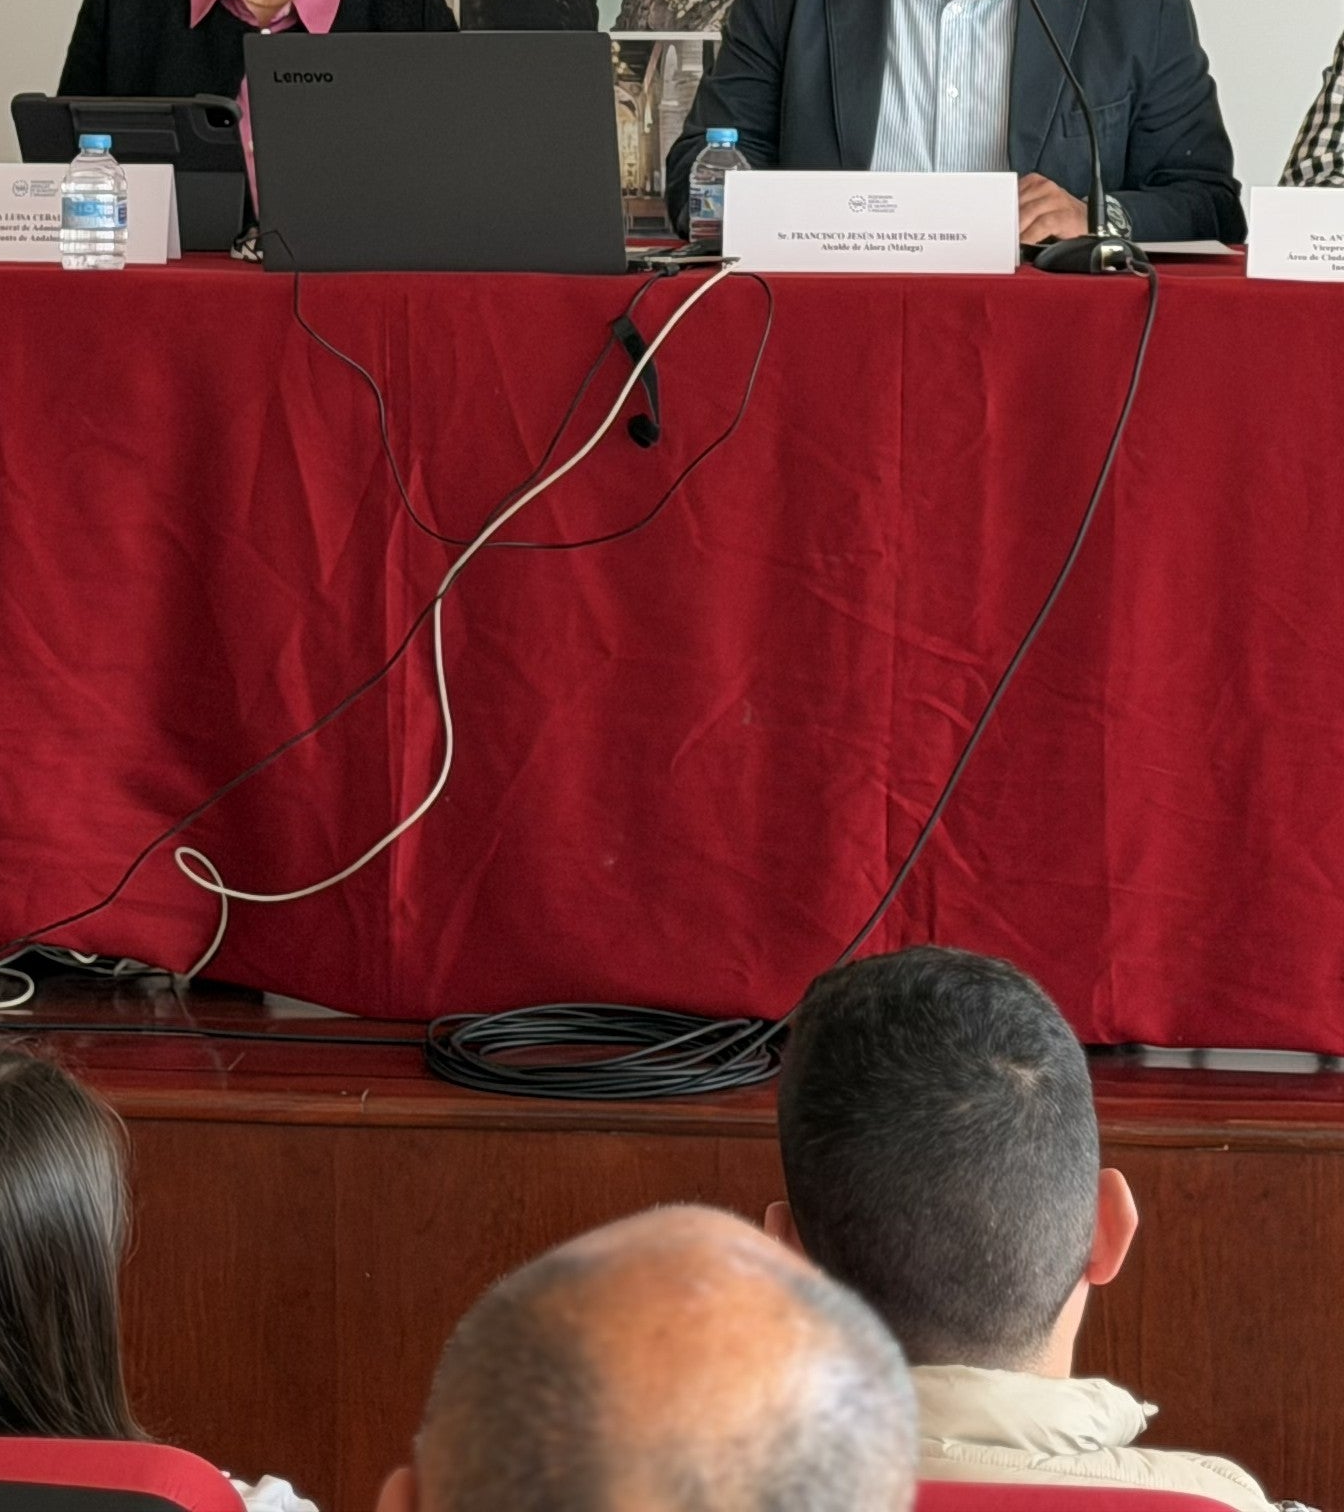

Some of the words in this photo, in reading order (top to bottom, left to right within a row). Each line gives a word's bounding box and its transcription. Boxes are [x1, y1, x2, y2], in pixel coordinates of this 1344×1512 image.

[272, 70, 335, 84] Lenovo
[791, 231, 846, 240] FRANCISCO
[875, 231, 926, 241] MARTÍNEZ
